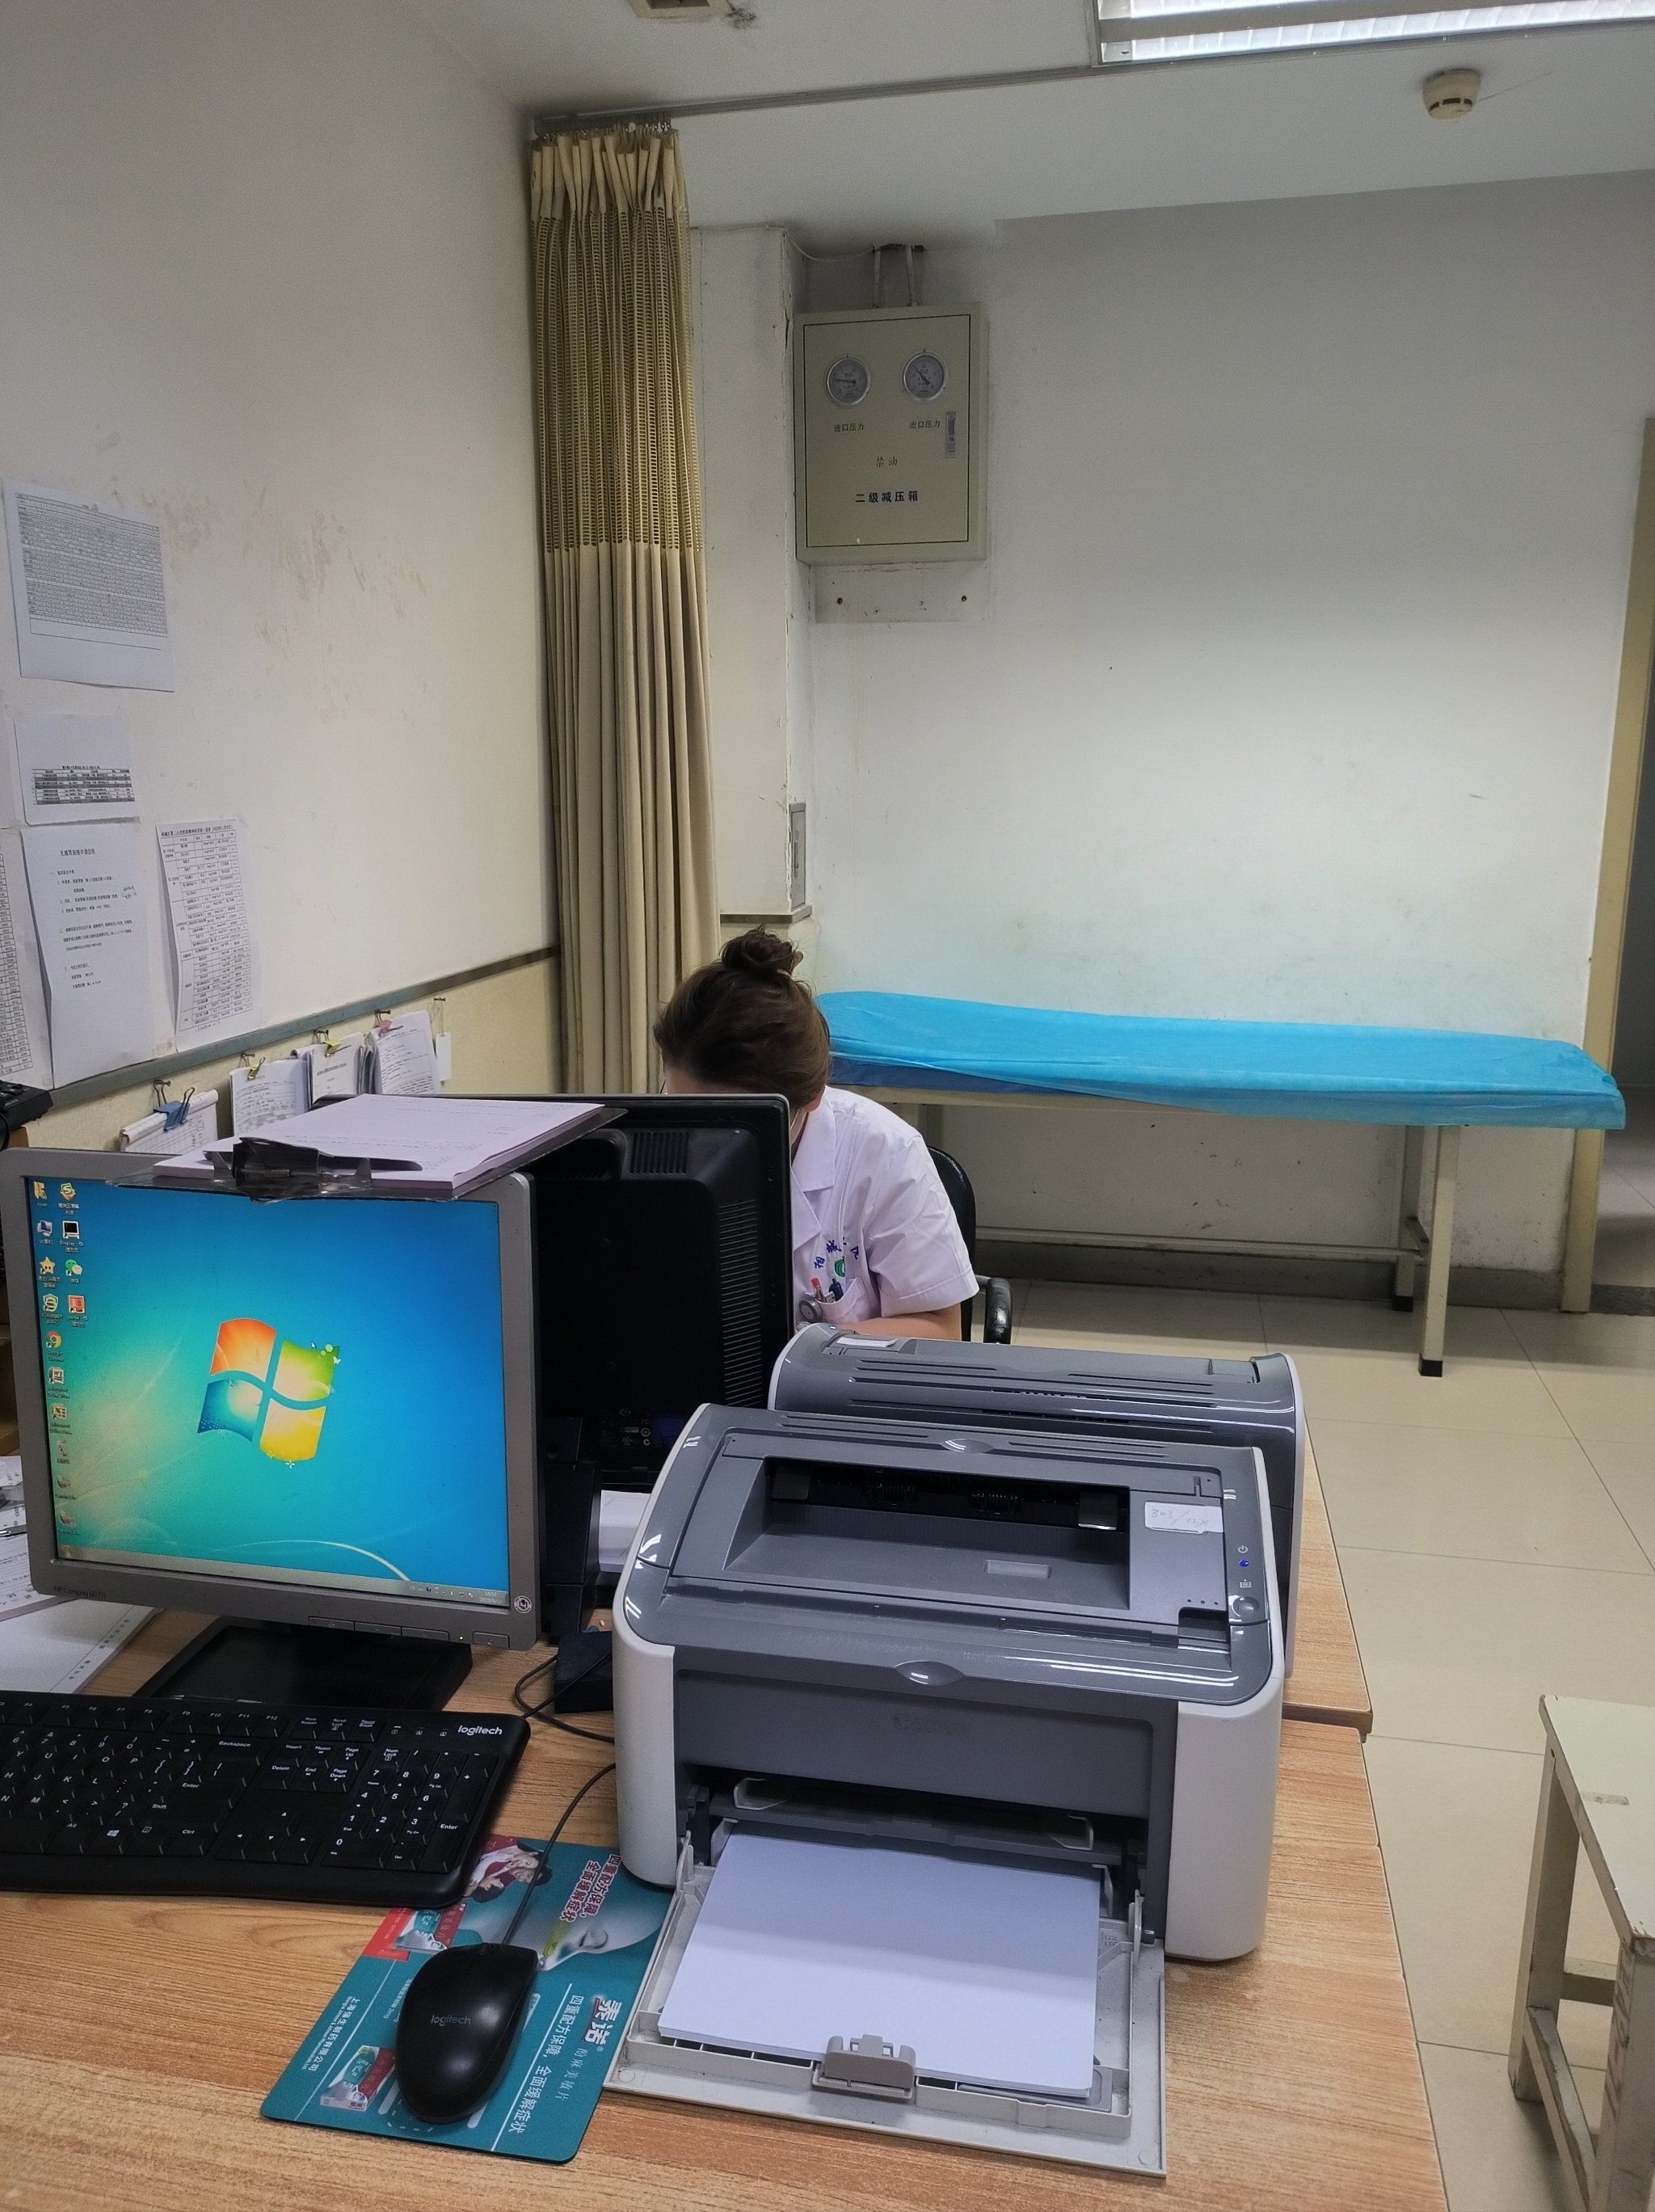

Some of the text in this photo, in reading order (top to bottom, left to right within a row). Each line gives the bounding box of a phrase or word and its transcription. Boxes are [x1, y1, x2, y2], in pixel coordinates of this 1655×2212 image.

[909, 420, 941, 429] 出口压力
[855, 490, 919, 503] 二级减压箱
[457, 1725, 503, 1736] logitech
[559, 1860, 601, 1922] 全面缓解症状
[431, 2014, 471, 2026] logitech
[584, 1999, 622, 2046] 泰诺
